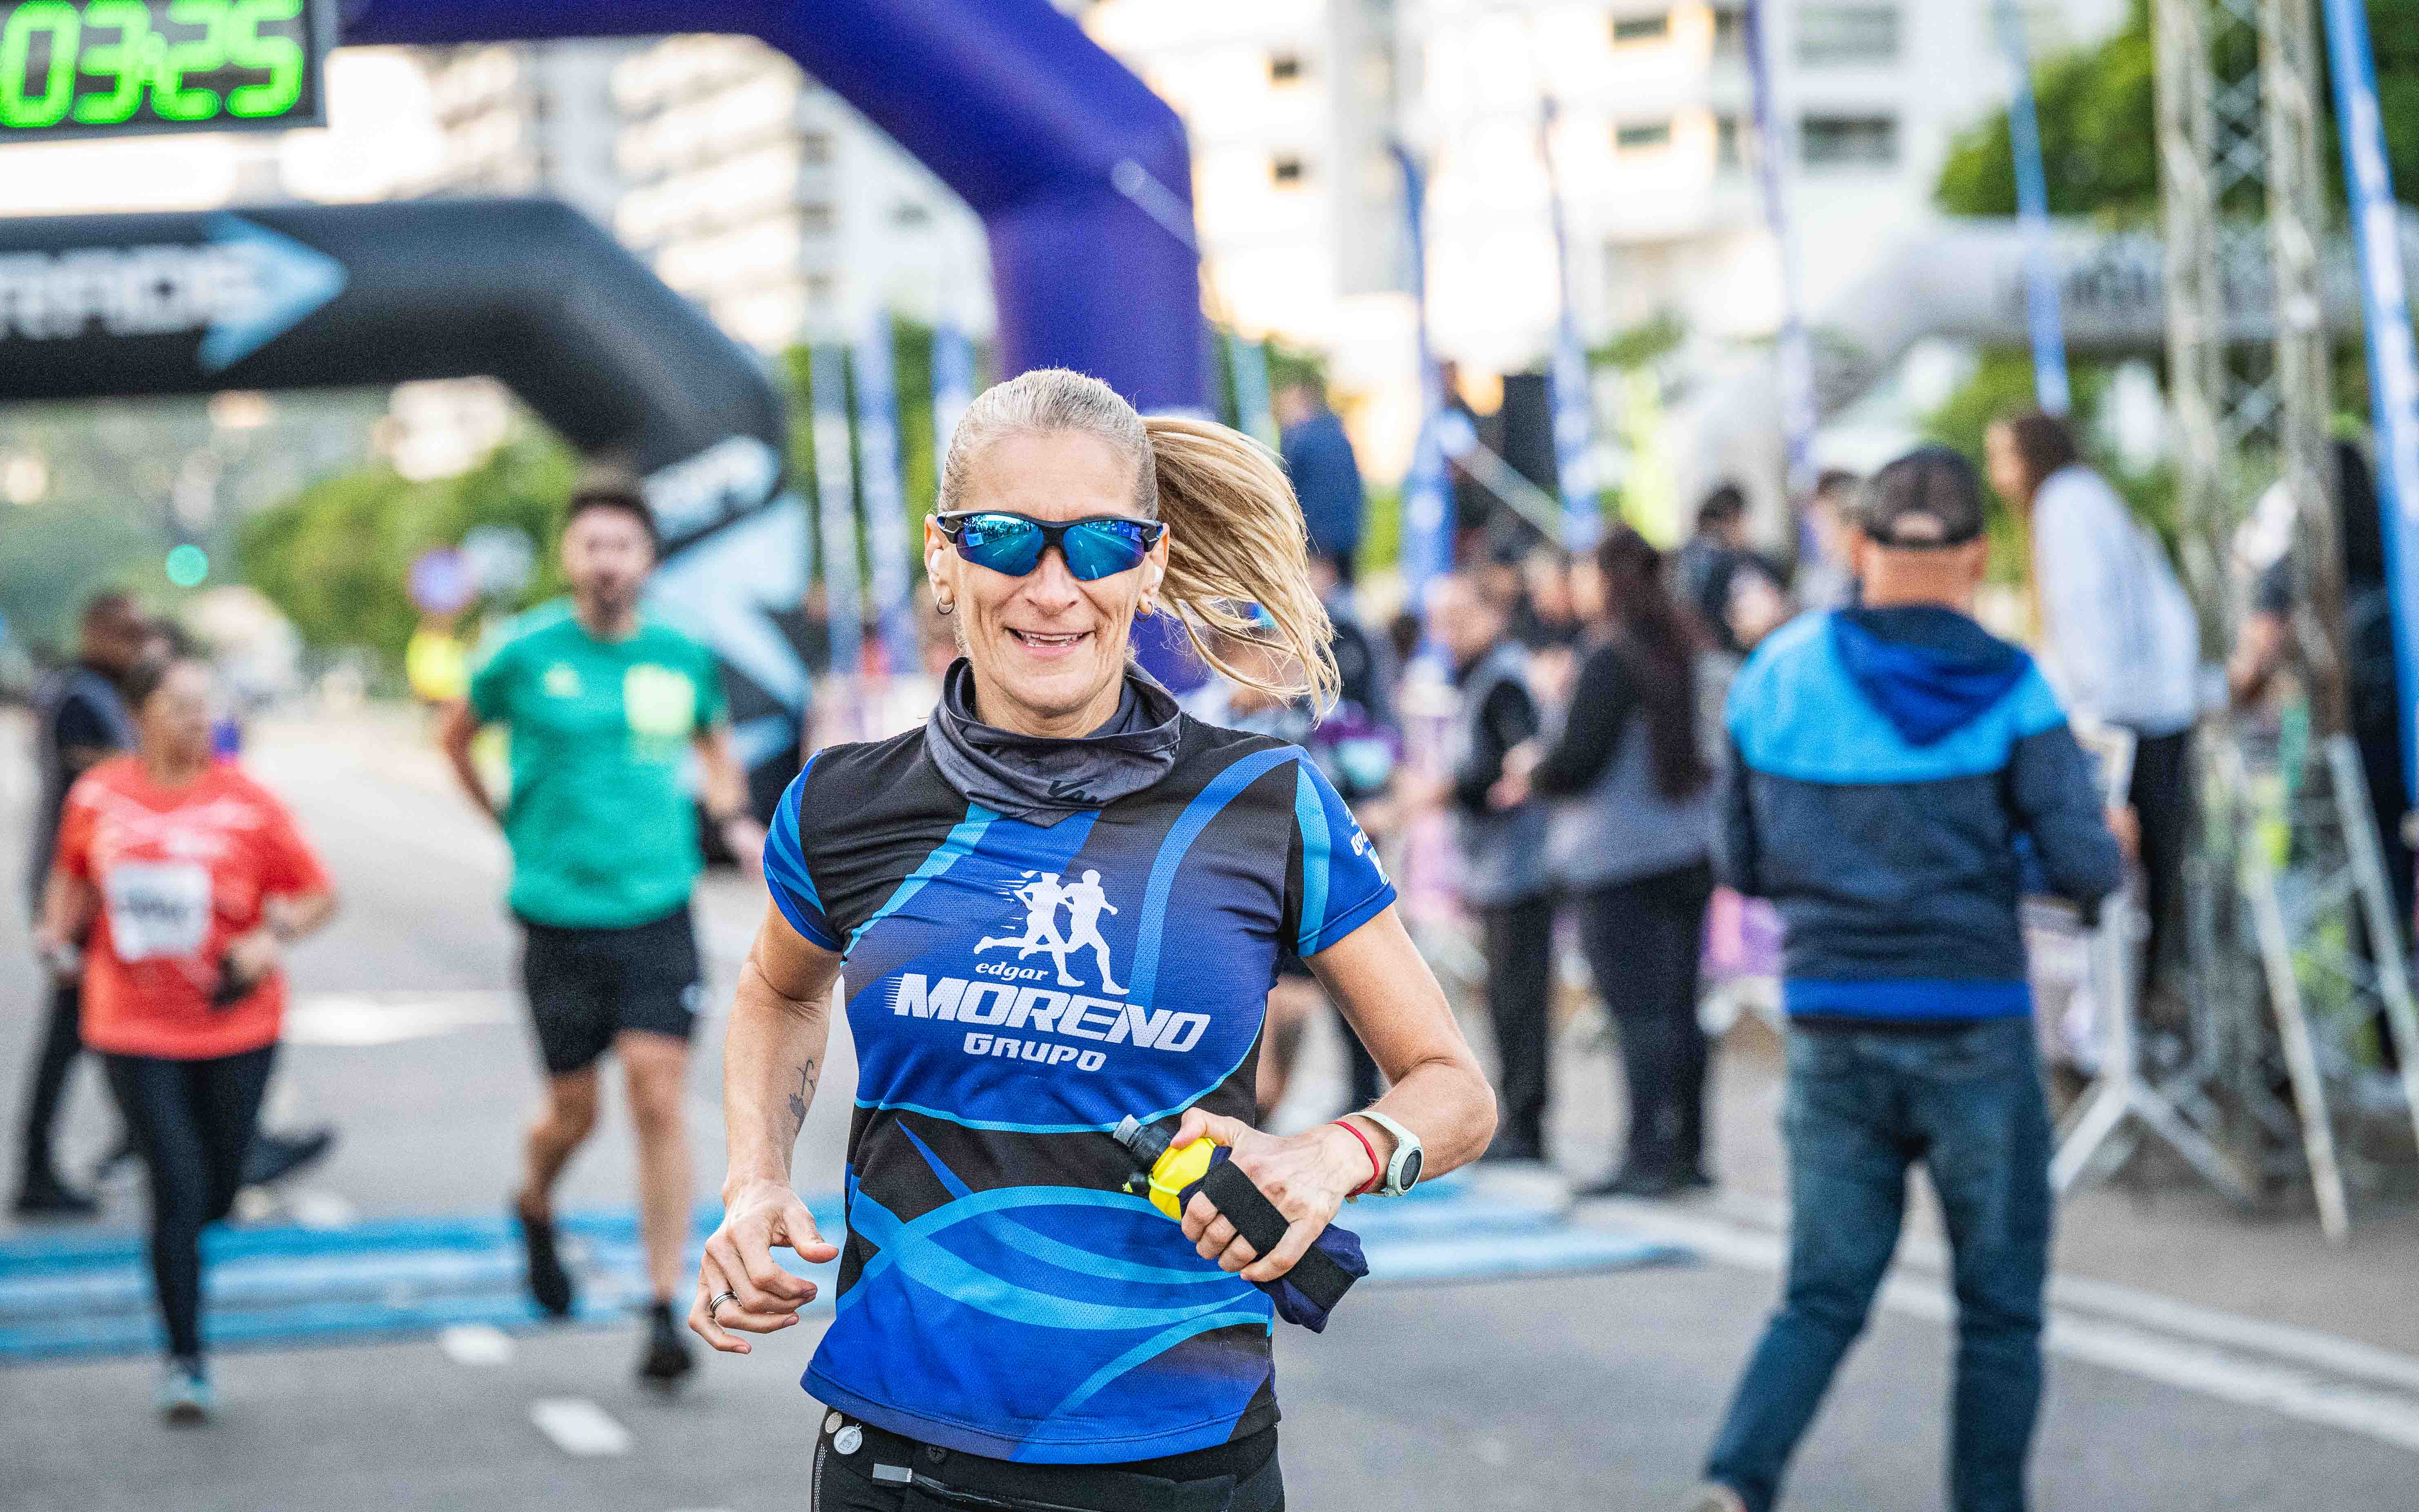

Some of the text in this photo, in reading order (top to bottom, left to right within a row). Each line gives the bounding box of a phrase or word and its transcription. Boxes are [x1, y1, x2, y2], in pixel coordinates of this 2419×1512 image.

[975, 961, 1048, 981] edgar
[894, 973, 1211, 1052] MORENO
[963, 1032, 1107, 1072] GRUPO
